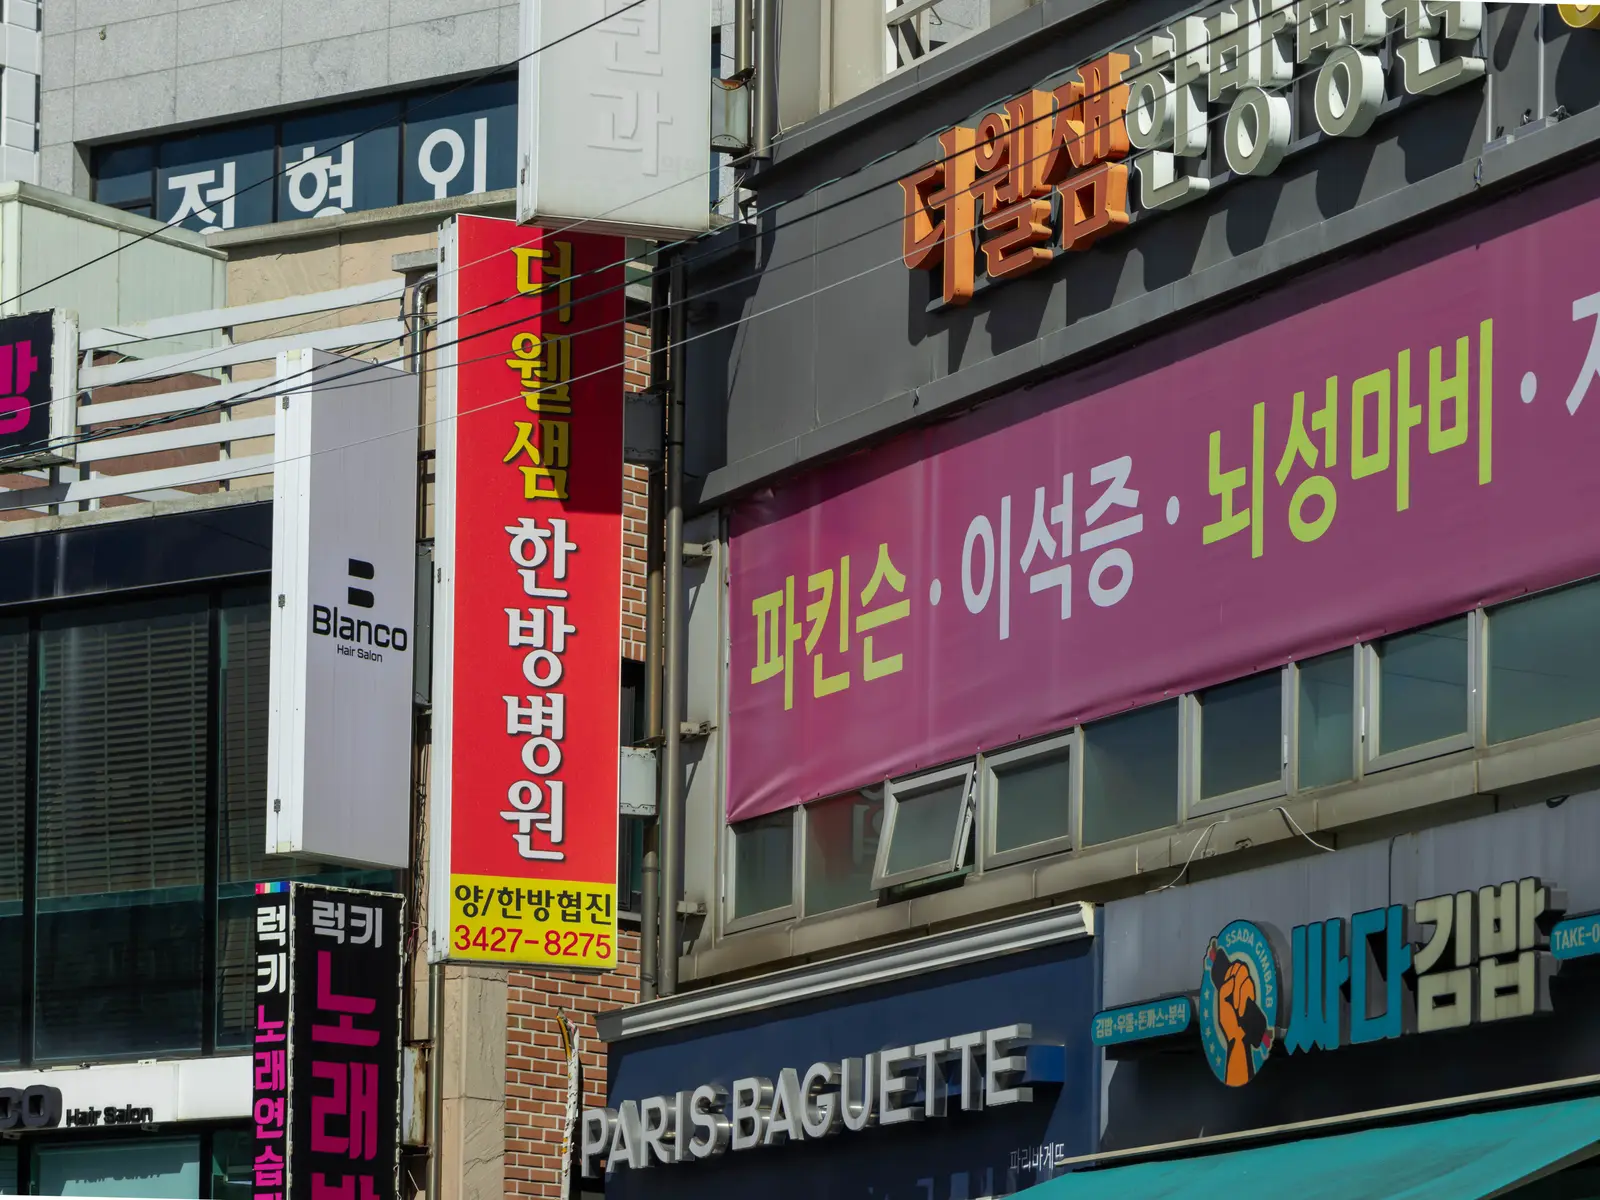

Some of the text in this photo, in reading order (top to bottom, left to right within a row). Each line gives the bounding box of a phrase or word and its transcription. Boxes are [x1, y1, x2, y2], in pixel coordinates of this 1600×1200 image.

[313, 604, 408, 652] Blanco
[337, 644, 383, 662] Hair Salon
[500, 517, 577, 860] 한방병원
[312, 899, 383, 948] 럭키
[454, 884, 612, 925] 양/한방협진
[454, 924, 612, 960] 3427-8275
[1225, 927, 1255, 948] SSADA
[66, 1106, 102, 1127] Hair
[103, 1103, 153, 1125] Salon
[253, 1004, 286, 1200] 노래연습
[580, 1022, 1034, 1178] PARIS BAGUETTE
